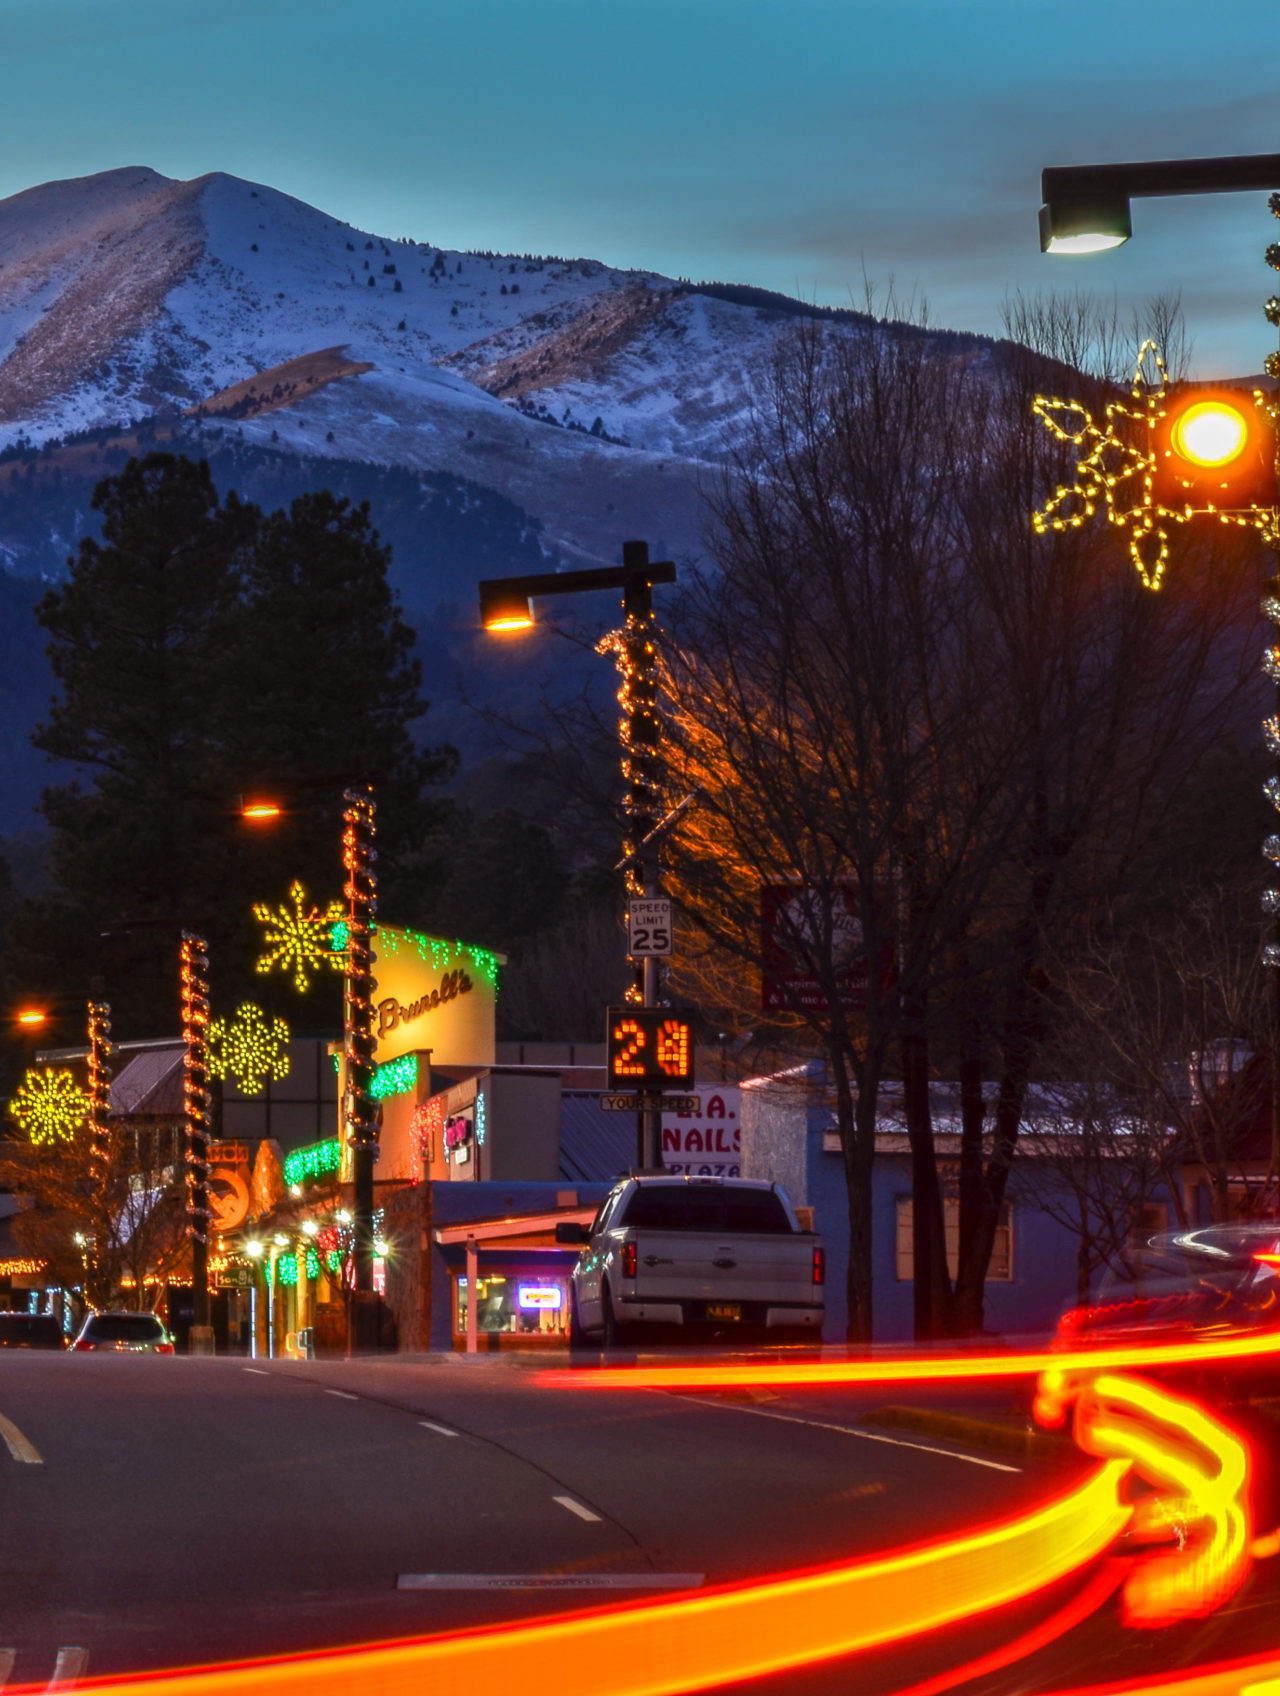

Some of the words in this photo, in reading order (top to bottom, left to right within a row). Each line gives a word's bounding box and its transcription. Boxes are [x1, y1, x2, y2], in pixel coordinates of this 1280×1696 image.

[631, 903, 669, 913] SPEED
[636, 915, 664, 925] LIMIT
[633, 928, 670, 950] 25
[377, 968, 473, 1040] Brunell's
[607, 1097, 643, 1110] YOUR
[651, 1097, 695, 1110] SPEED
[677, 1095, 736, 1119] .A.
